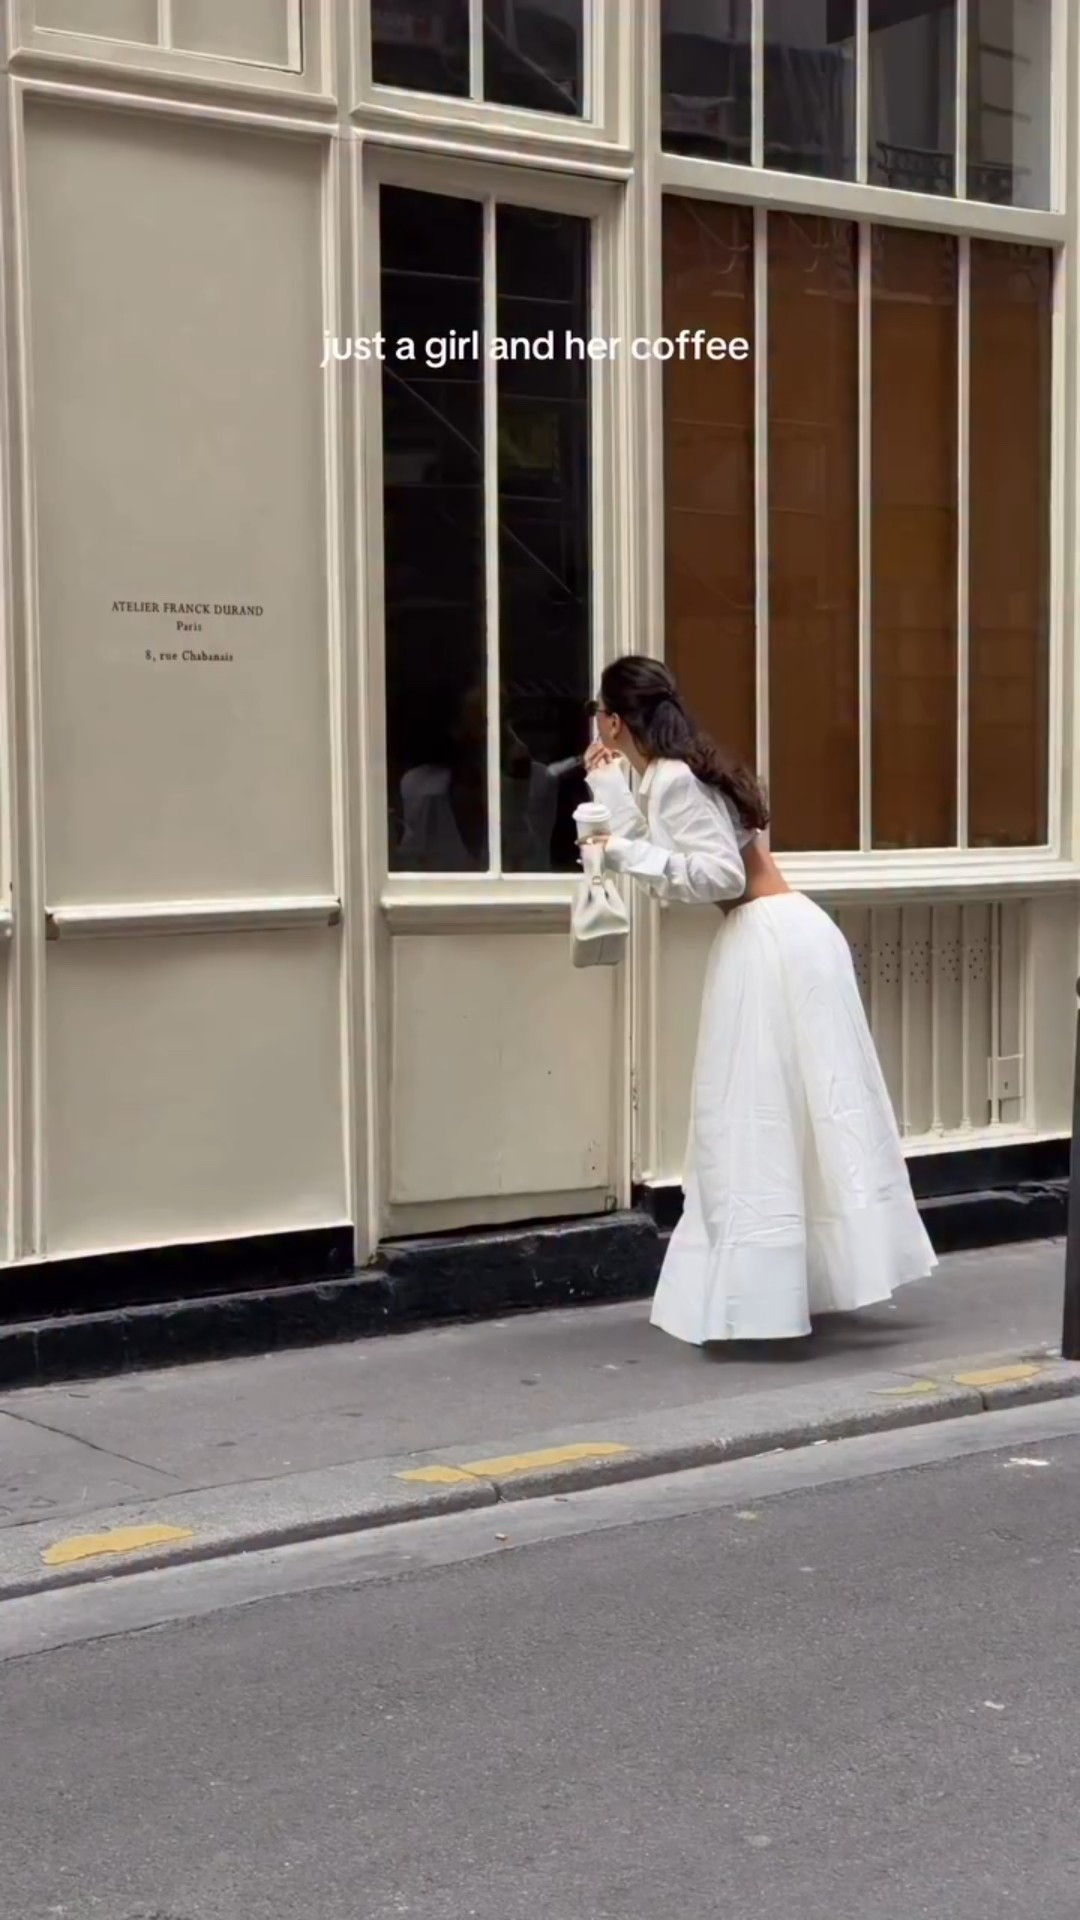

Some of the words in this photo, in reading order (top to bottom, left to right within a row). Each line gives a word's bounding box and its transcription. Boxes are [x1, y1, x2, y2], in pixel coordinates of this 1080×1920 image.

[112, 601, 160, 613] ATELIER
[163, 602, 211, 614] FRANCK
[213, 604, 264, 616] DURAND
[176, 620, 202, 632] Paris
[145, 649, 157, 662] 8,
[159, 652, 178, 661] rue
[182, 650, 234, 662] Chabanais
